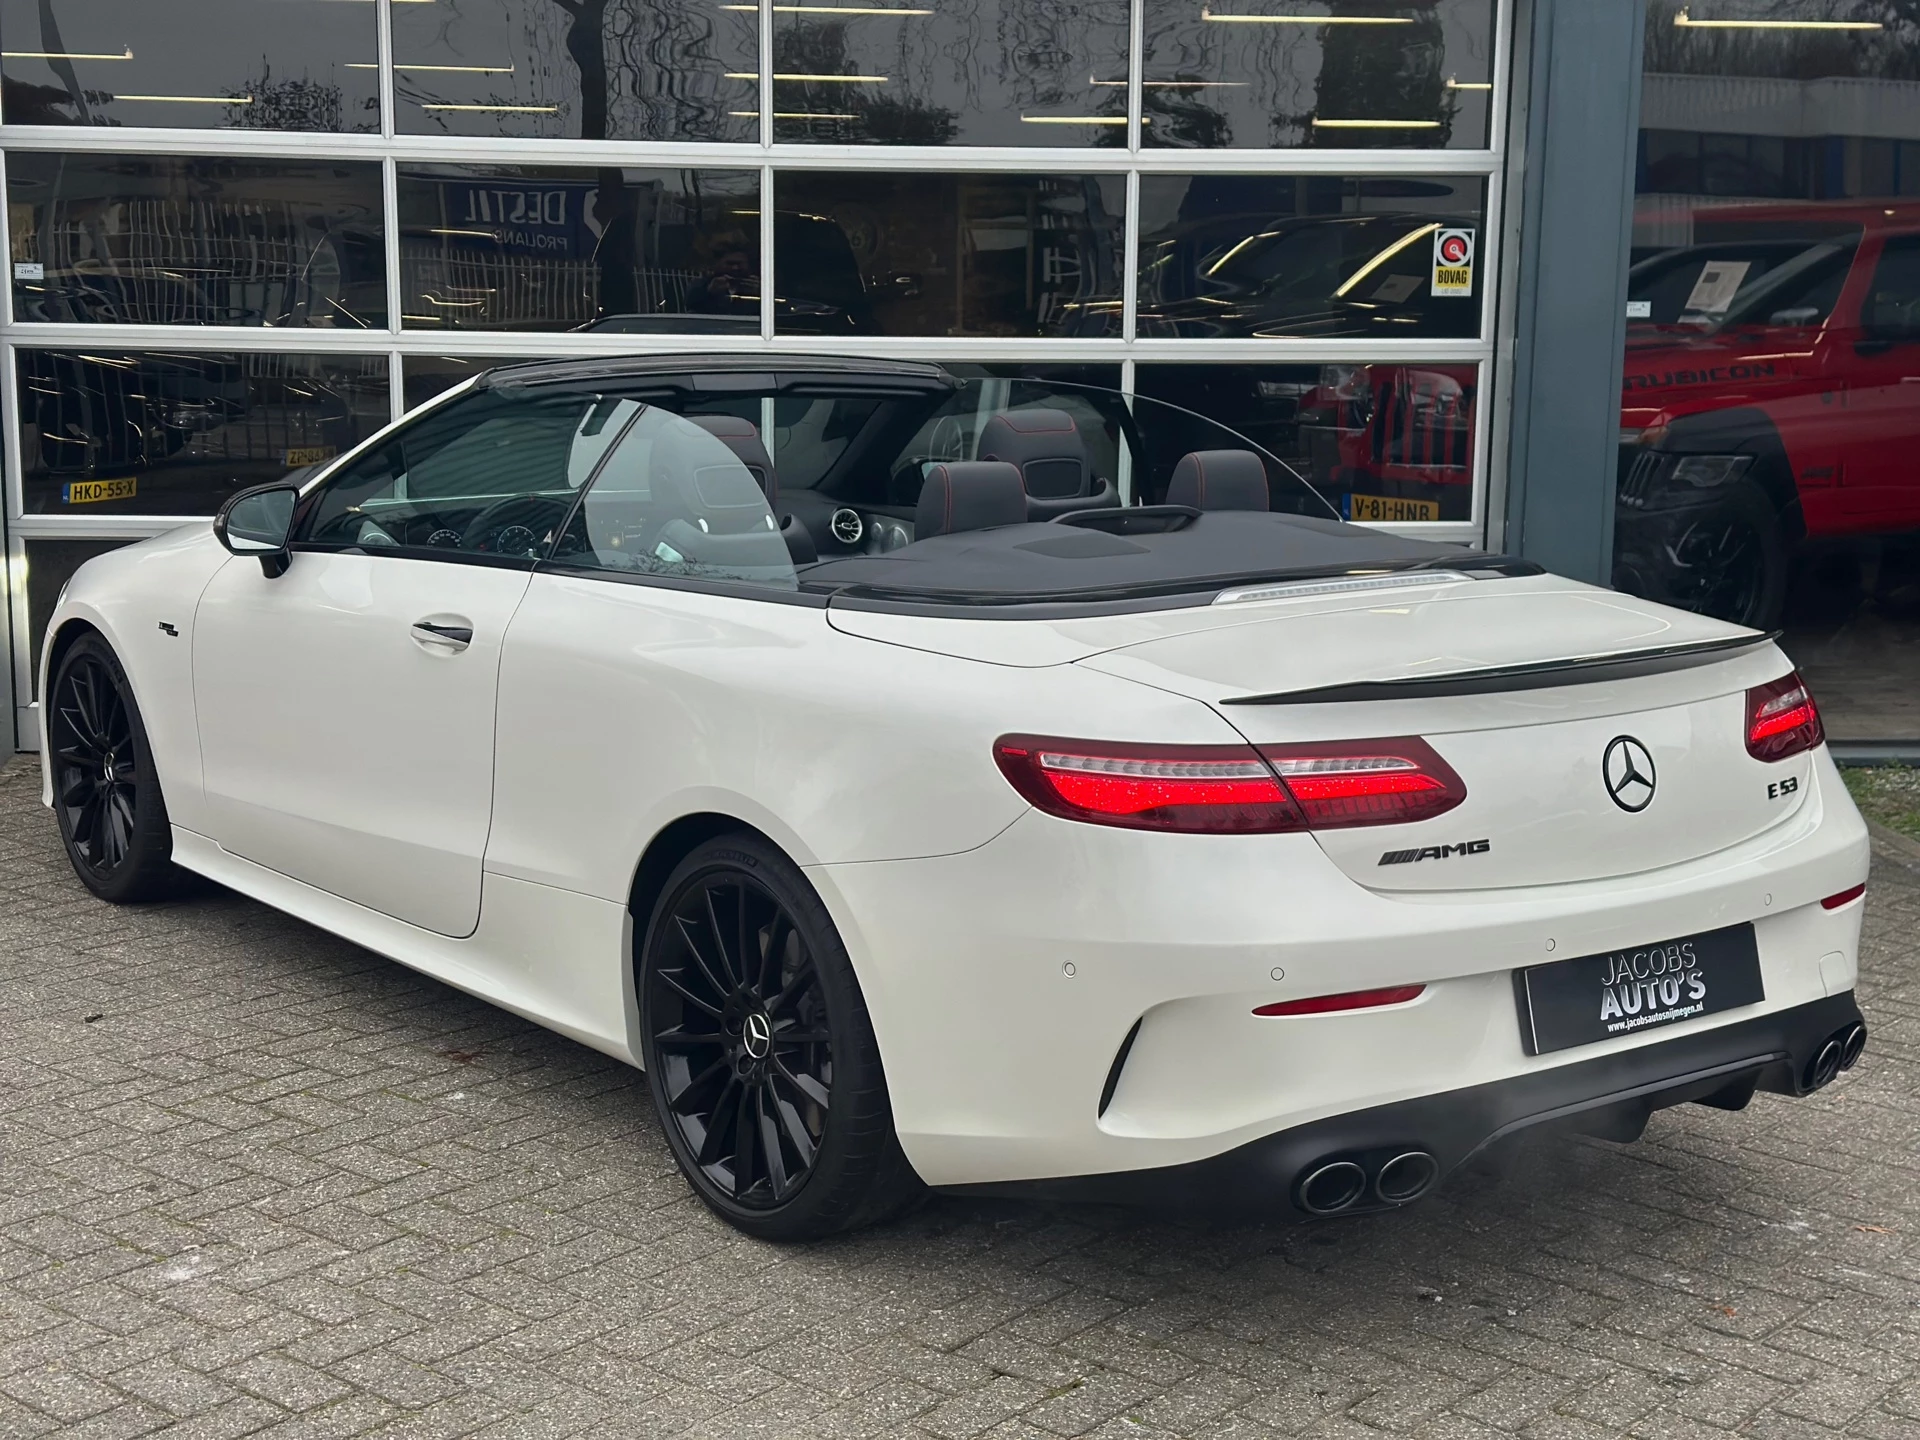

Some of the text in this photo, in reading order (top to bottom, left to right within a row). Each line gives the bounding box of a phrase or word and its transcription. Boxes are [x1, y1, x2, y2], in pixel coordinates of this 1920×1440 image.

[1437, 269, 1468, 285] BOVAG
[1623, 364, 1775, 391] RUBICON
[73, 480, 134, 501] HKD-55-X
[1767, 776, 1798, 800] E 53
[1414, 839, 1490, 862] AMG
[1601, 942, 1696, 986] JACOBS
[1600, 968, 1706, 1021] AUTO'S
[1607, 1001, 1704, 1033] www.jacobsautosnijmegen.nl
